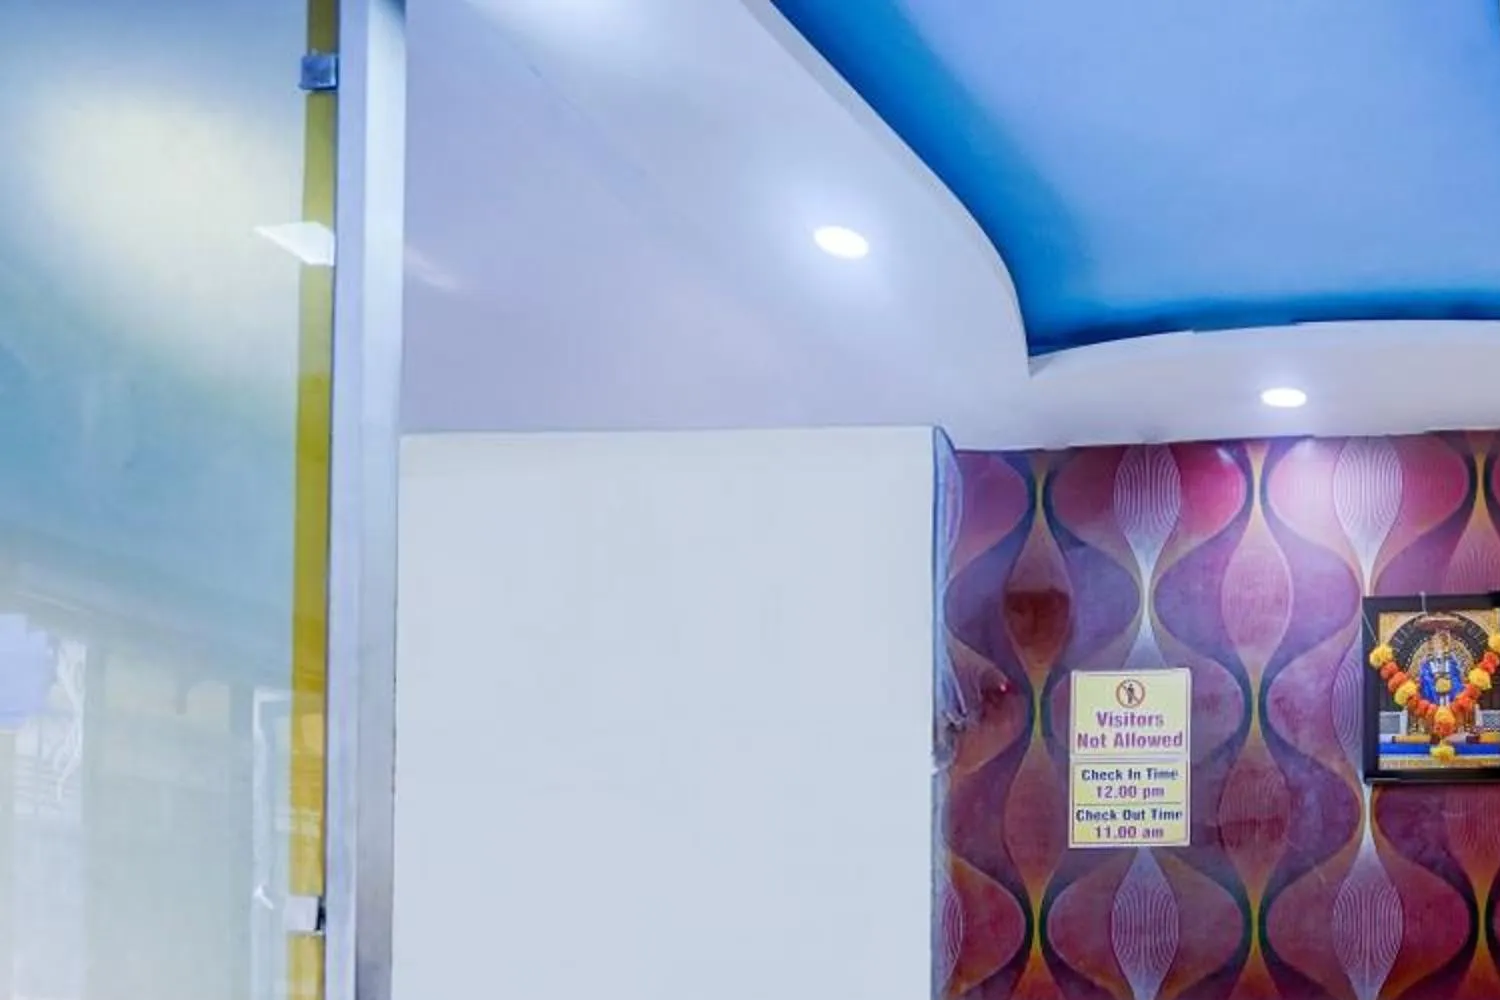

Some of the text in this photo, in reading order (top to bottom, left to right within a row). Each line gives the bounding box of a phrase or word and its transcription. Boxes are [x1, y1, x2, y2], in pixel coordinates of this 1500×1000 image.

[1096, 710, 1164, 728] Visitors
[1077, 731, 1183, 749] Not Allowed
[1081, 767, 1178, 781] Check In Time
[1096, 785, 1164, 800] 12.00 pm
[1076, 809, 1182, 821] Check Out Time
[1094, 826, 1164, 839] 11.00 am
